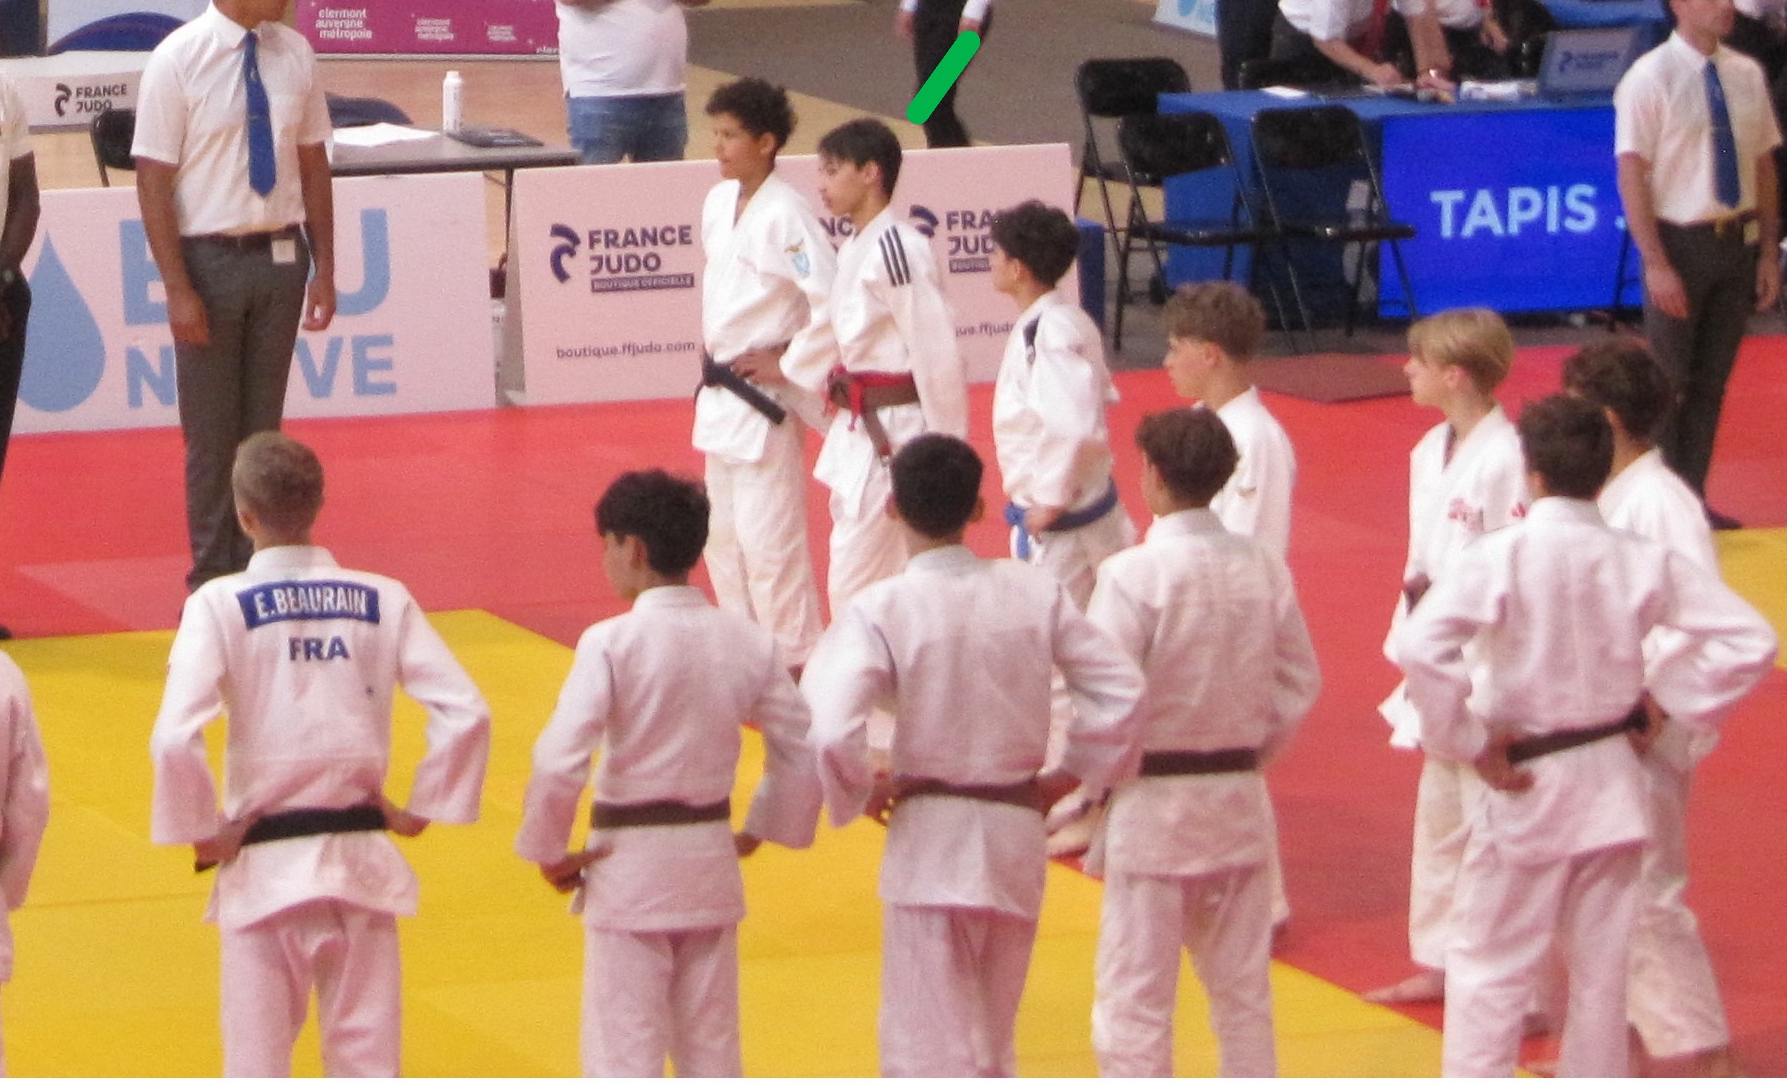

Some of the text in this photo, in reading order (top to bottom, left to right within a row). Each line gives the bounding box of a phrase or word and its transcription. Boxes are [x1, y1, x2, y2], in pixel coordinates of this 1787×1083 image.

[76, 84, 127, 98] FRANCE
[76, 99, 113, 113] JUDO
[1431, 184, 1598, 240] TAPIS
[588, 225, 693, 250] FRANCE
[589, 252, 662, 275] JUDO
[557, 341, 695, 358] boutique.ffjudo.com
[125, 334, 397, 408] NVE
[253, 586, 367, 619] E.BEAURAIN
[289, 635, 350, 661] FRA
